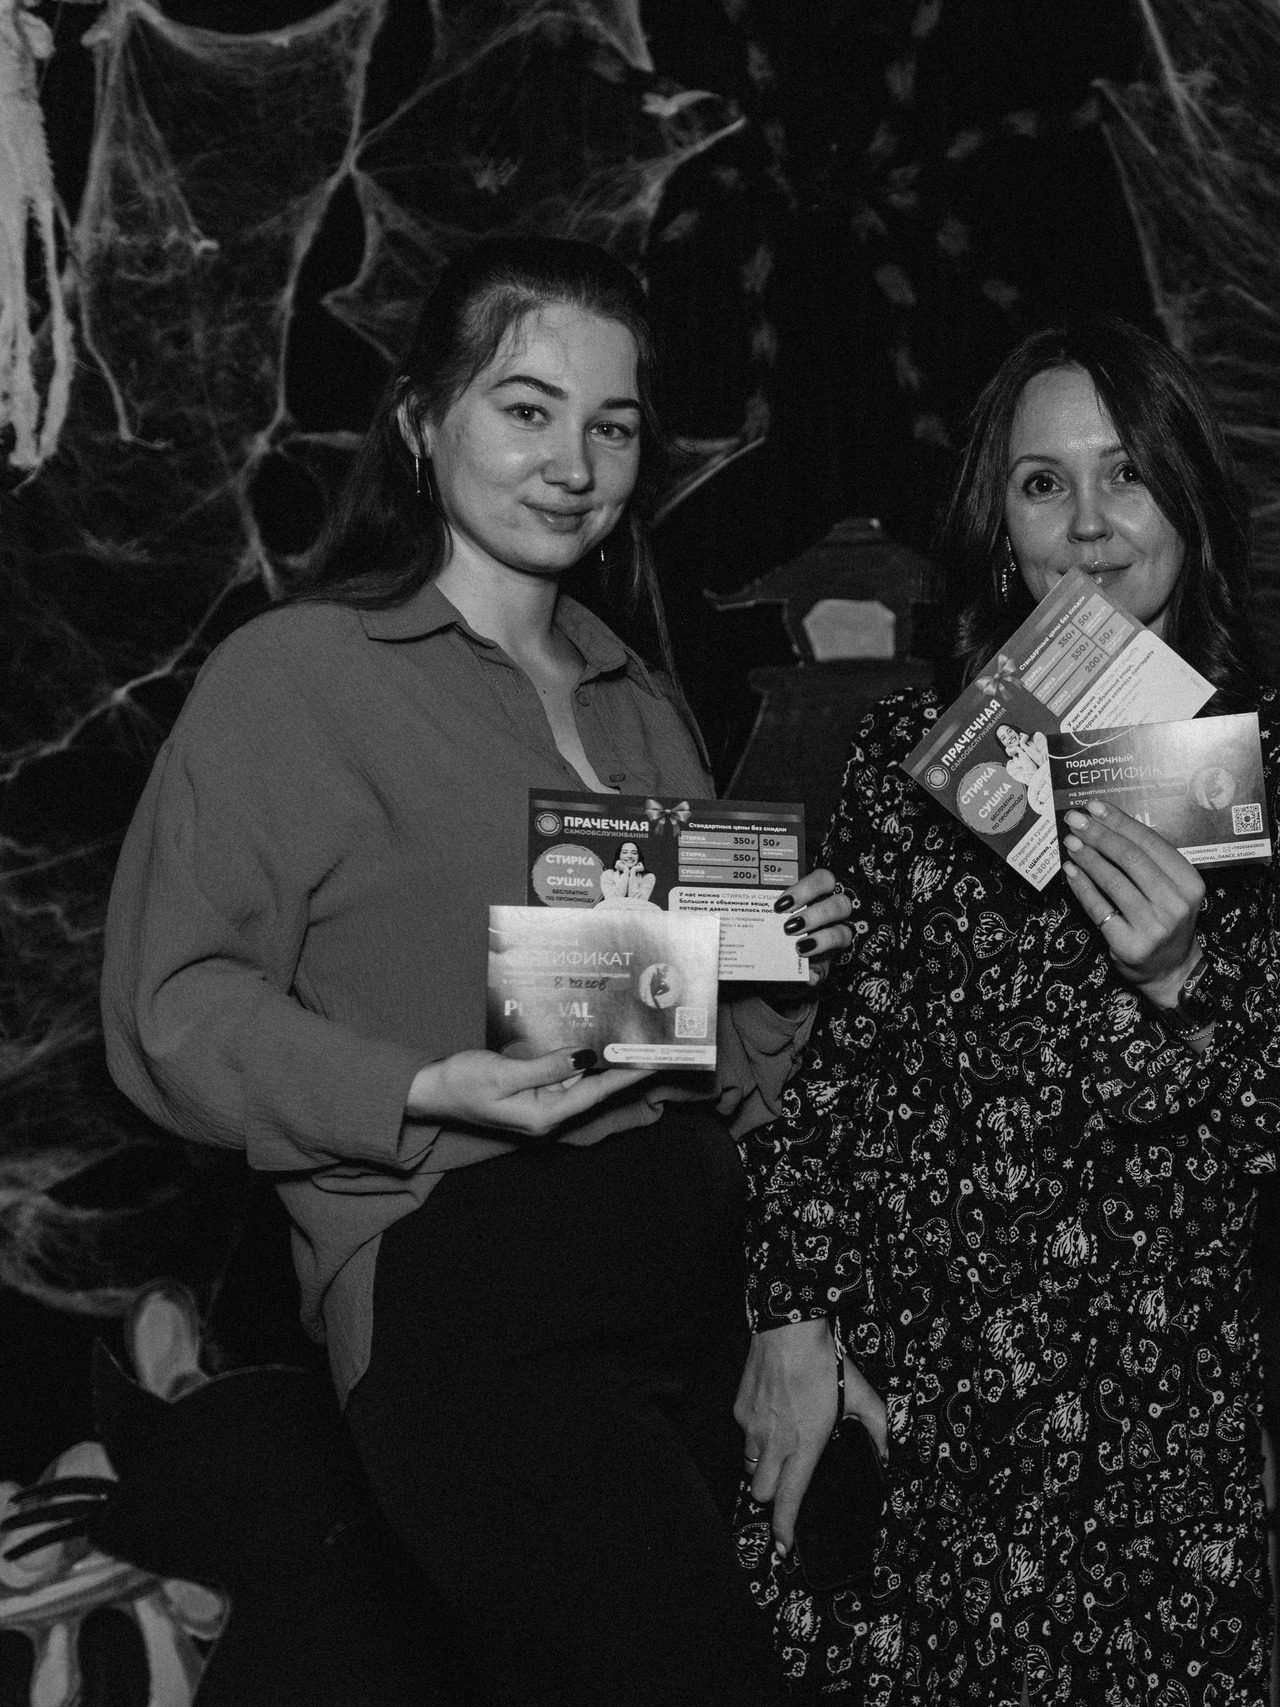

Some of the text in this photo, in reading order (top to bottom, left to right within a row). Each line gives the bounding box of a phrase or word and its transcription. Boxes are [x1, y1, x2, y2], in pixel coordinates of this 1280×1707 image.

[1018, 636, 1050, 671] Стандартные
[1047, 622, 1062, 638] цены
[1058, 612, 1070, 624] без
[1067, 594, 1086, 615] скидки
[1023, 664, 1042, 686] СТИРКА
[1036, 676, 1056, 697] СТИРКА
[1050, 689, 1068, 709] СУШКА
[1070, 712, 1080, 723] нас
[1079, 694, 1096, 713] можно
[940, 698, 1001, 766] ПРАЧЕЧНАЯ
[949, 706, 1006, 771] САМООБСЛУЖИВАНИЯ
[1065, 753, 1133, 769] ПОДАРОЧНЫЙ
[959, 765, 996, 805] СТИРКА
[1077, 788, 1106, 796] занятиях
[976, 781, 1011, 819] СУШКА
[990, 793, 1015, 821] БЕСПЛАТНО
[991, 792, 1025, 830] ПО ПРОМОКОДУ
[564, 816, 649, 832] ПРАЧЕЧНАЯ
[564, 828, 649, 838] САМООБСЛУЖИВАНИЯ
[689, 822, 731, 830] Стандартные
[1011, 841, 1030, 862] Стирка
[1033, 818, 1050, 837] сушка
[545, 854, 595, 866] СТИРКА
[1028, 843, 1051, 869] Щёлково,
[547, 876, 593, 887] СУШКА
